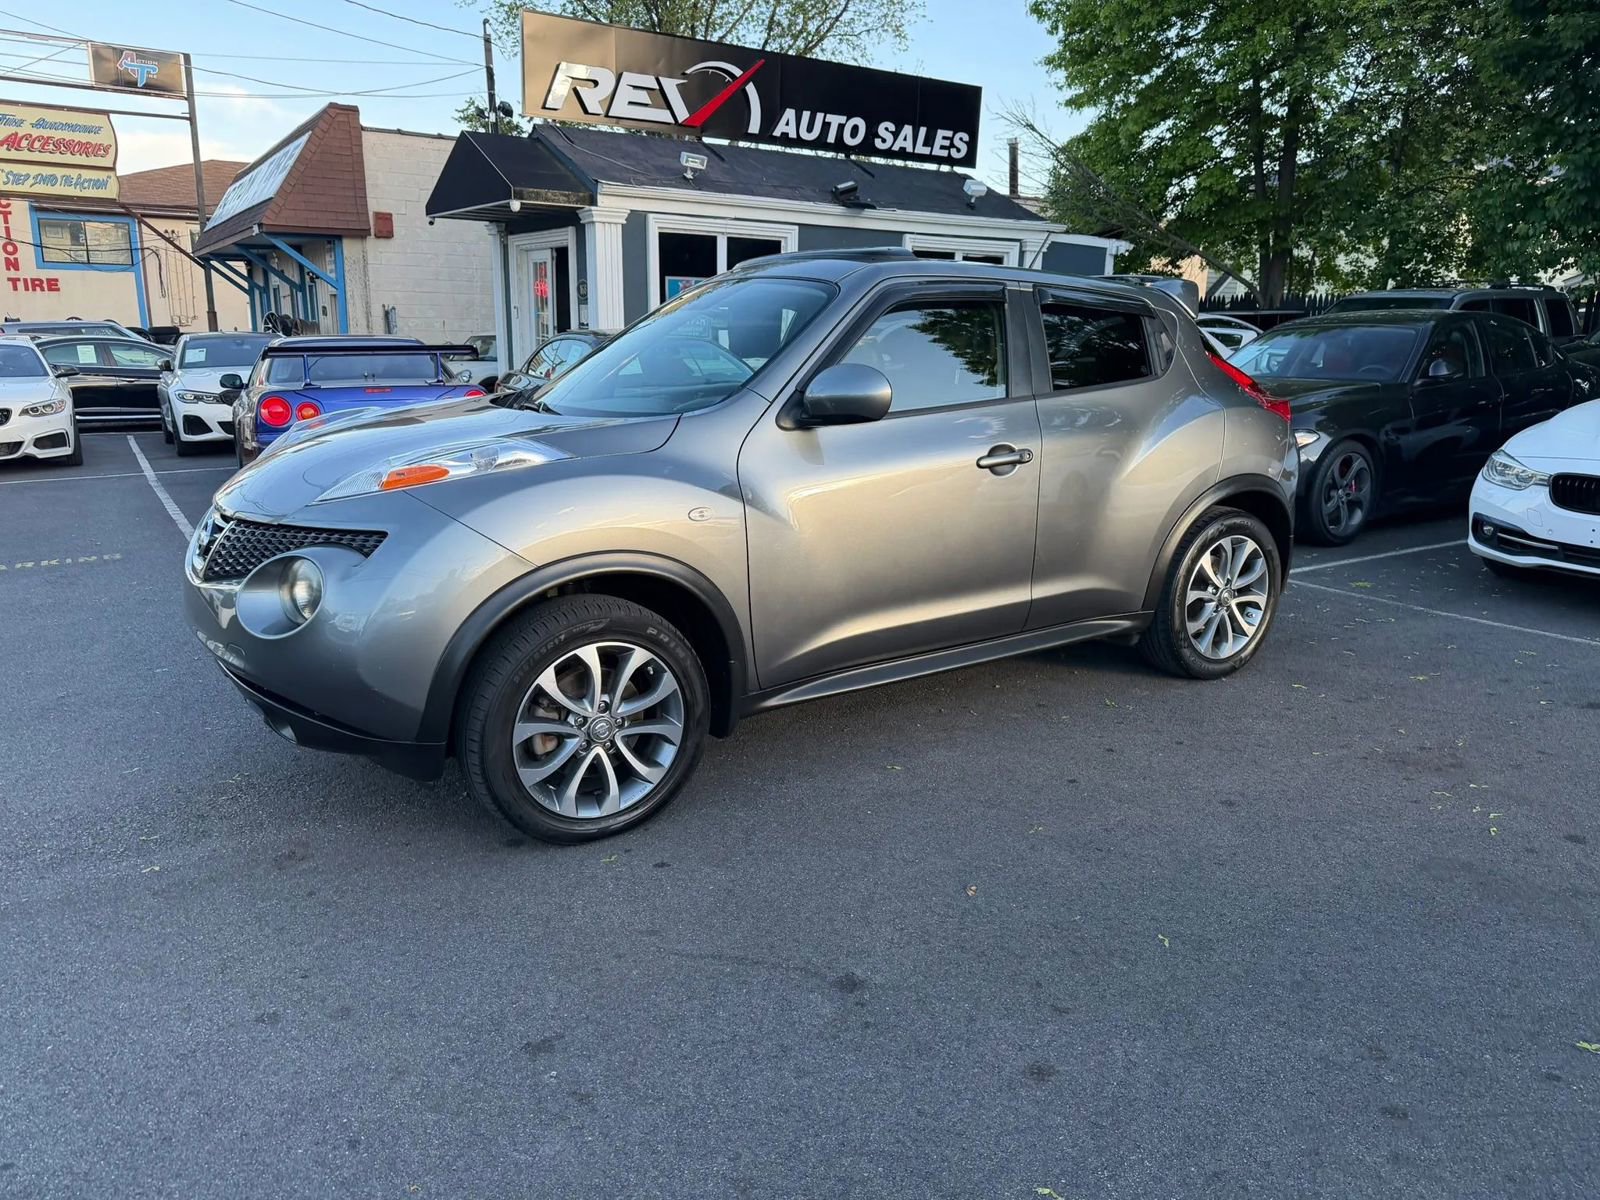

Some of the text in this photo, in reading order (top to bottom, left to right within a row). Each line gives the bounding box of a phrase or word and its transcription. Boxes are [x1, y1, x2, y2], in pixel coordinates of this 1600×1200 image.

[772, 107, 970, 159] AUTO SALES
[0, 131, 112, 158] ACCESSORIES
[30, 173, 59, 188] INTO
[7, 277, 61, 292] TIRE
